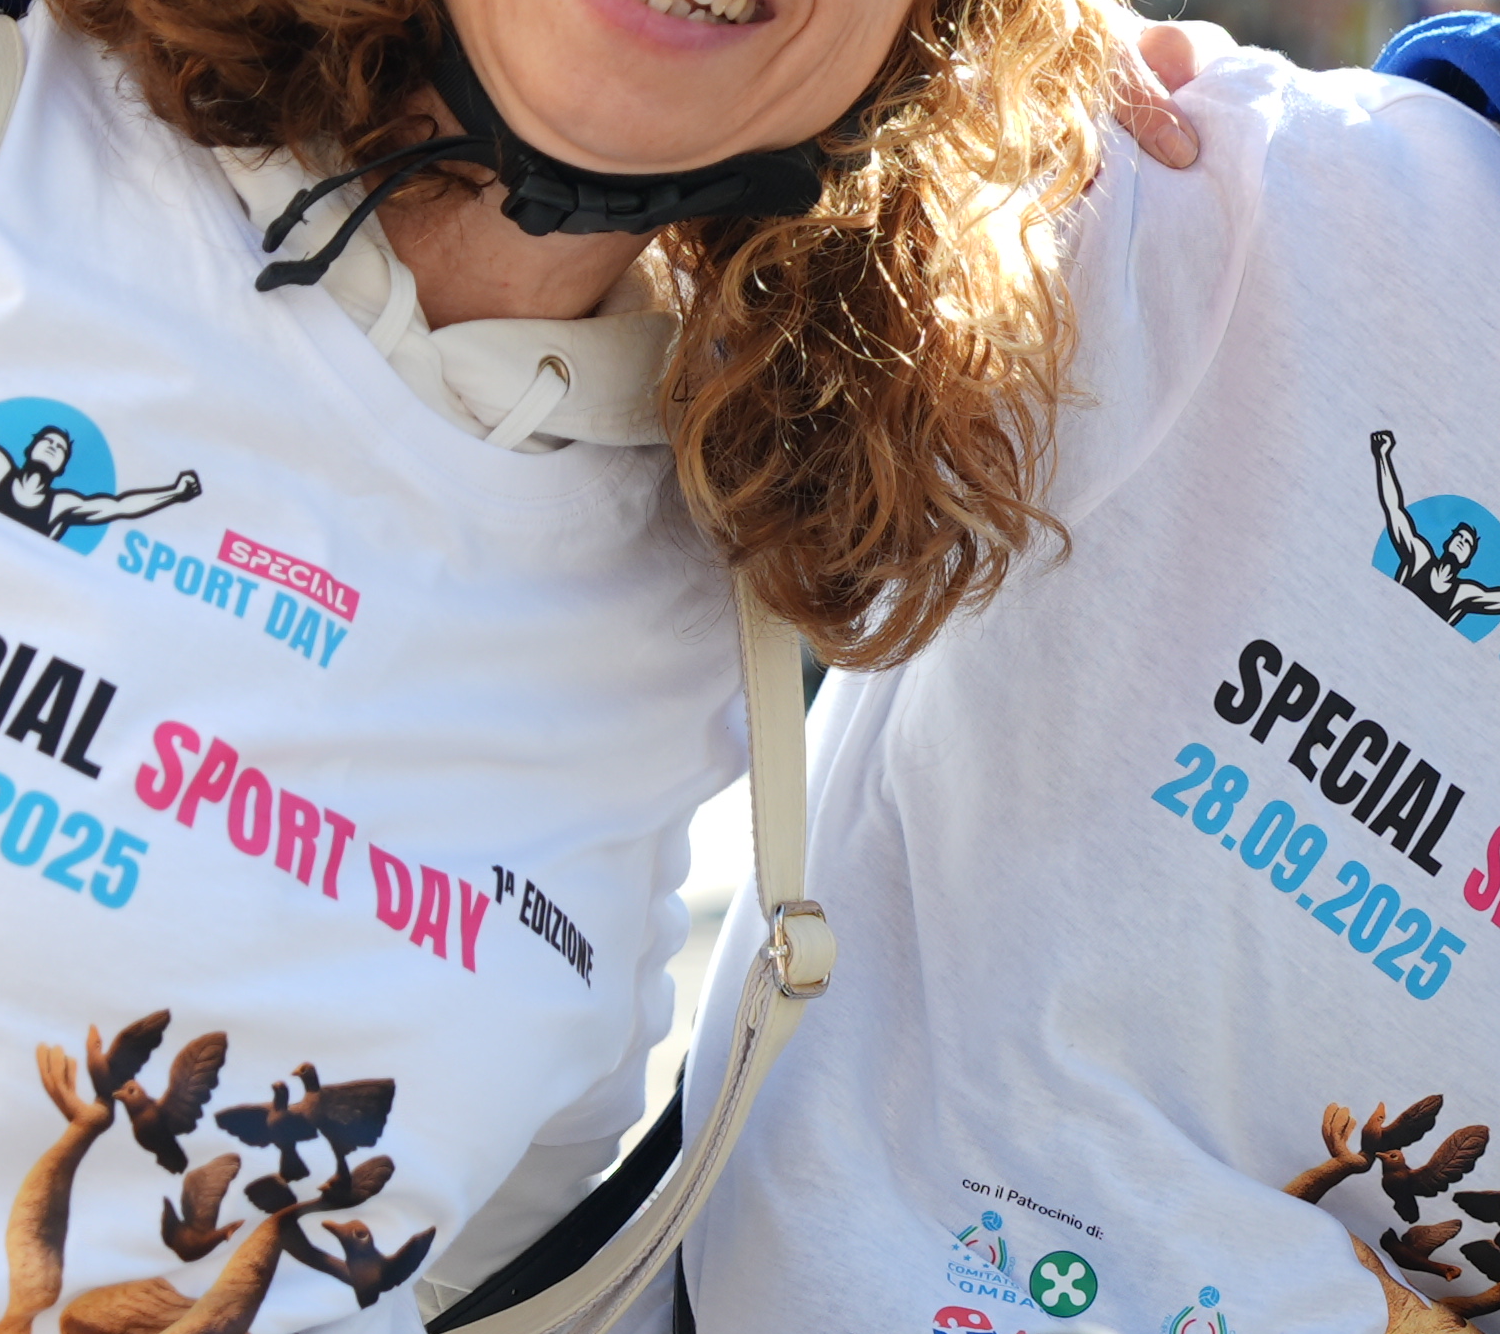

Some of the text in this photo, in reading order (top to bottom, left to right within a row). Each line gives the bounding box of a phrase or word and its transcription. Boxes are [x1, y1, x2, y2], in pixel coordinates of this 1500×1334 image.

[117, 529, 348, 670] SPORT DAY
[227, 538, 353, 618] SPECIAL
[1212, 639, 1468, 878] SPECIAL
[134, 720, 356, 902] SPORT
[367, 841, 490, 975] DAY
[518, 877, 595, 990] EDIZIONE
[1150, 741, 1467, 1003] 28.09.2025
[961, 1176, 1104, 1242] con il Patrocinio di:
